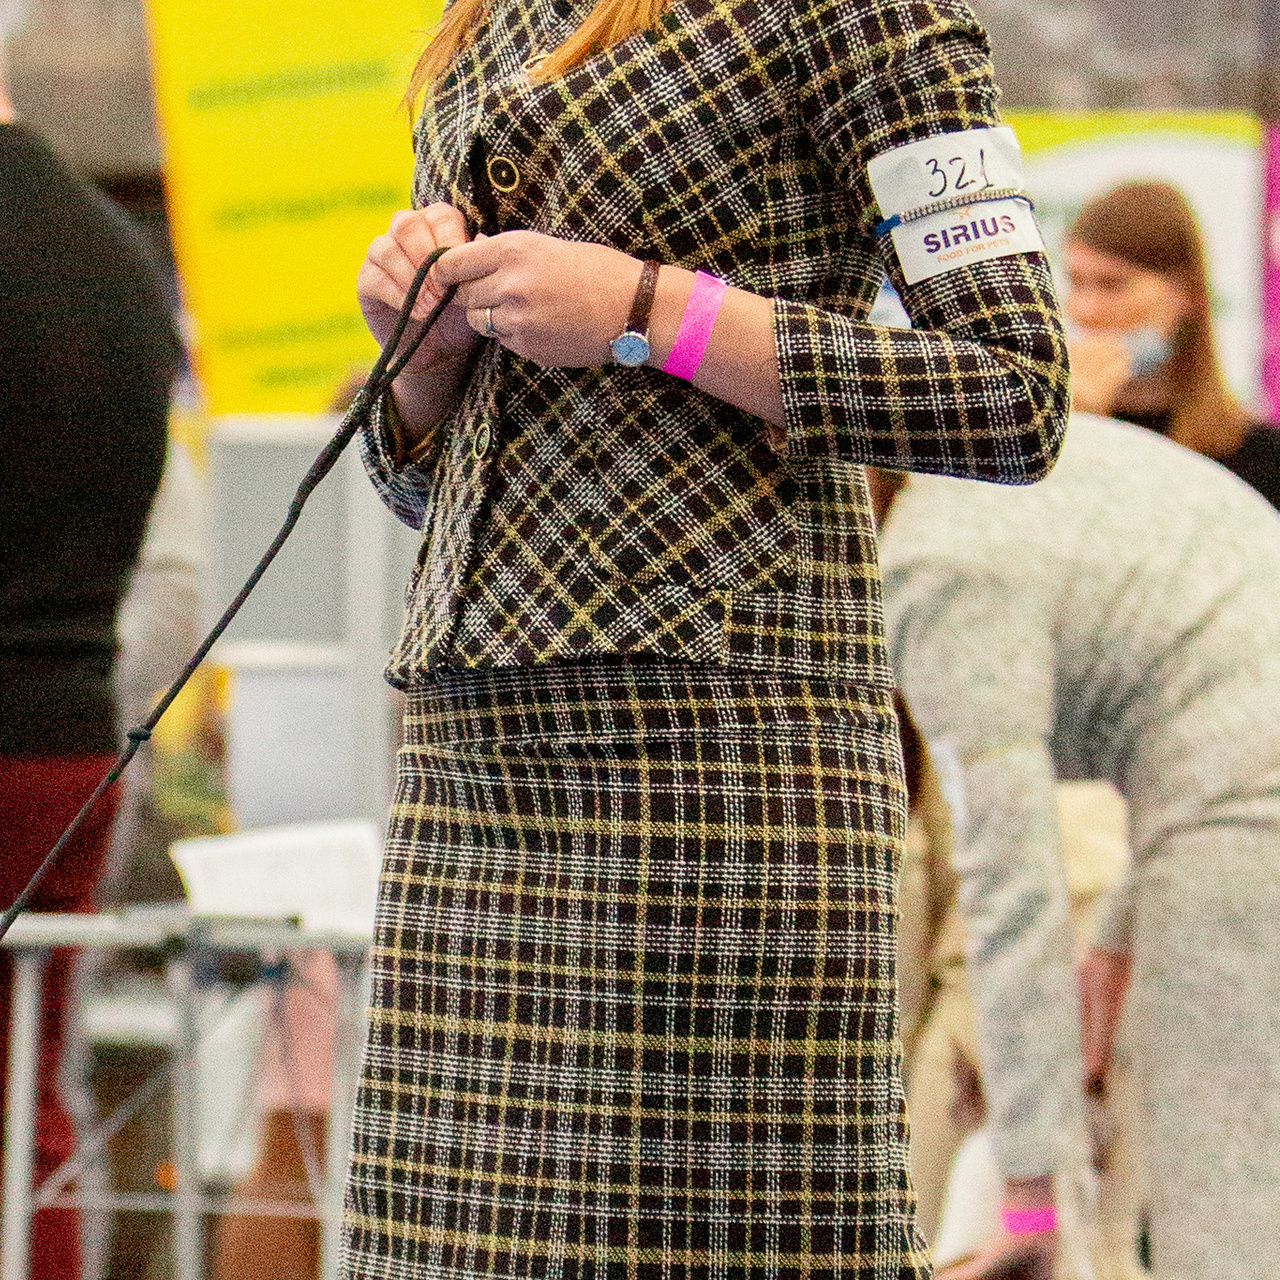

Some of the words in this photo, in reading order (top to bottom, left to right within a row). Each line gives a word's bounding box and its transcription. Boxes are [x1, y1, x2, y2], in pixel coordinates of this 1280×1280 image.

[926, 148, 994, 197] 321
[923, 215, 1016, 253] SIRIUS
[937, 249, 963, 263] FOOD
[966, 243, 986, 255] FOR
[987, 237, 1011, 249] PETS
